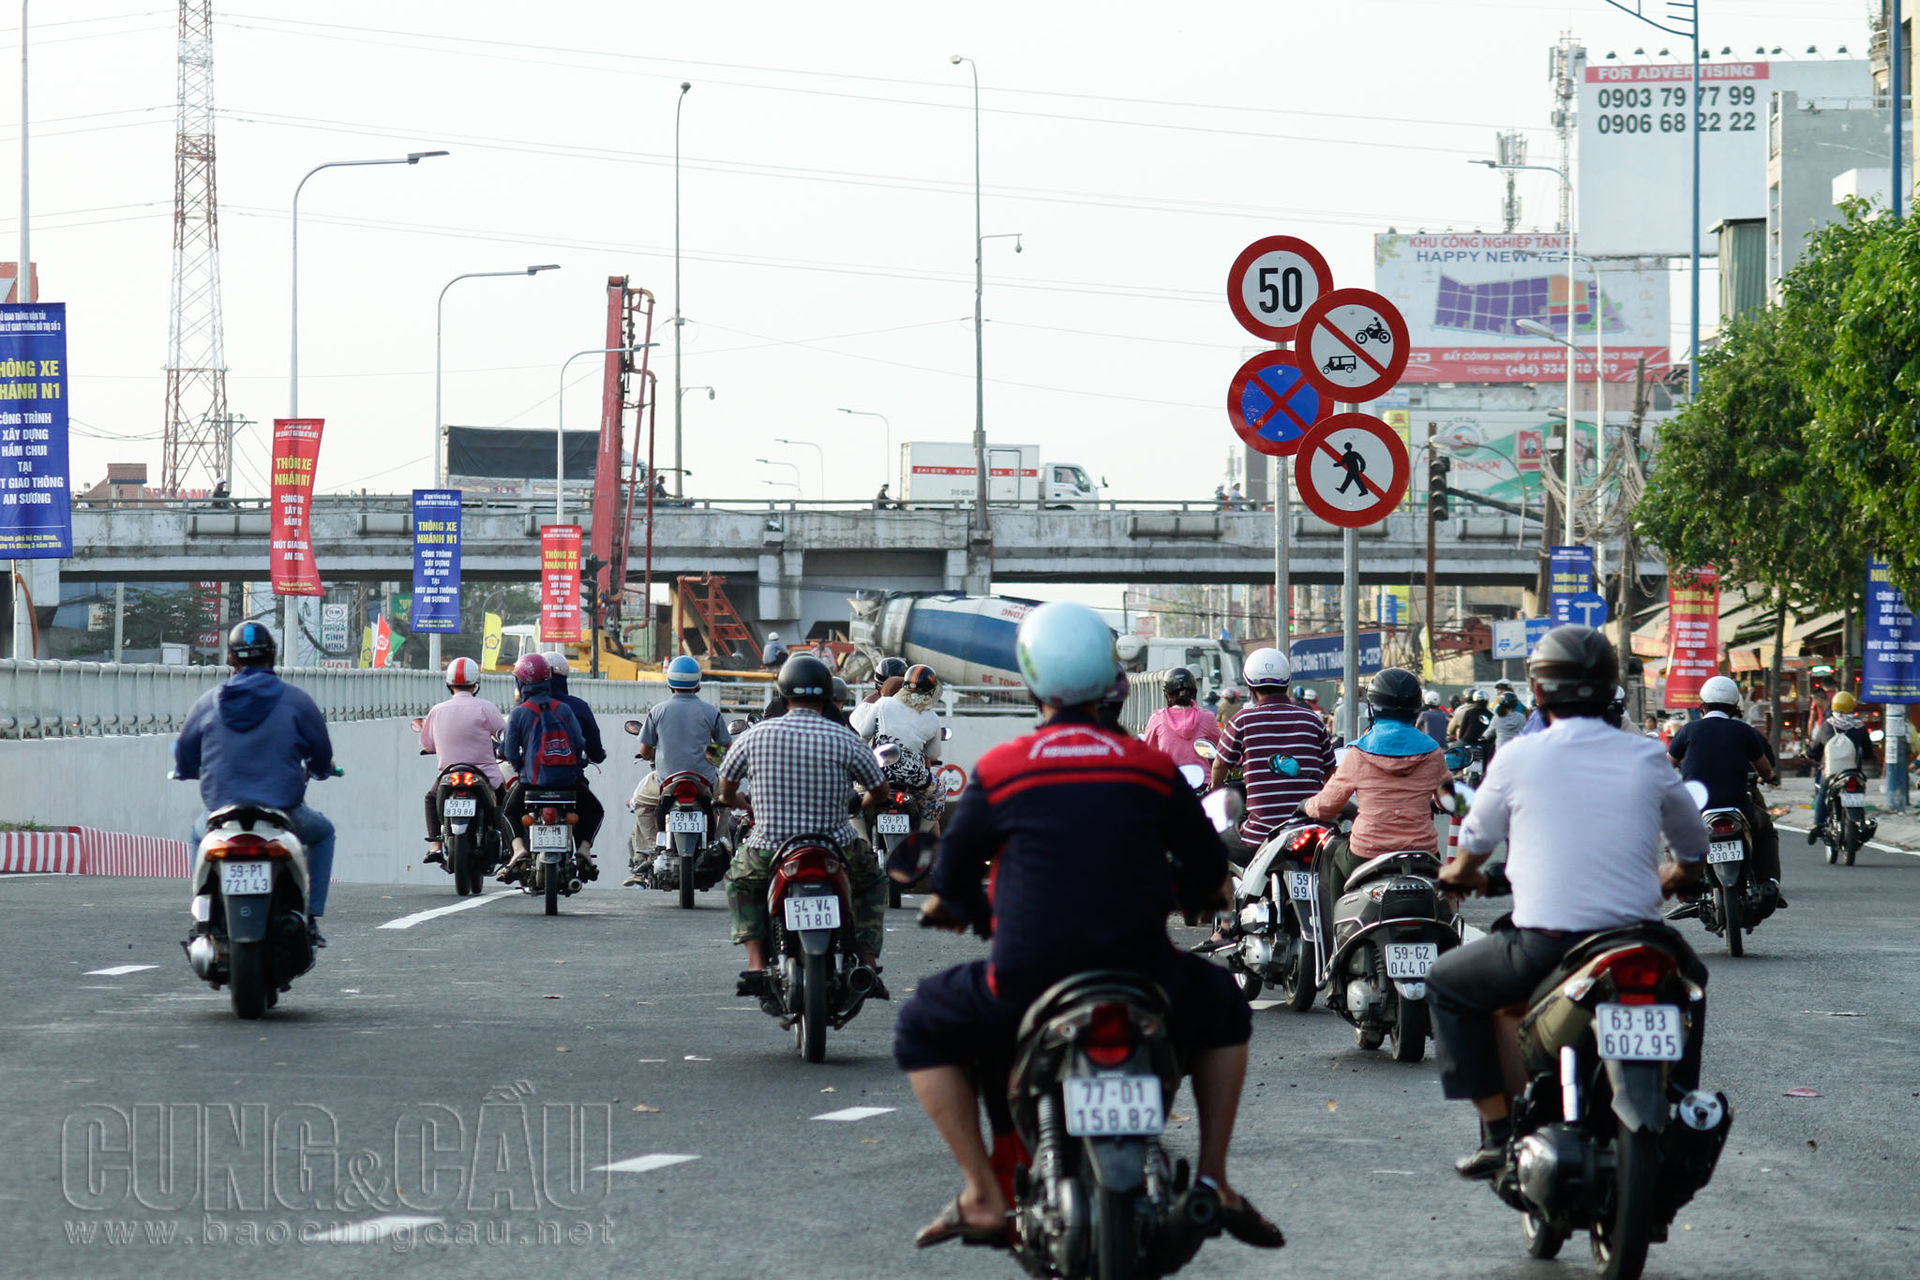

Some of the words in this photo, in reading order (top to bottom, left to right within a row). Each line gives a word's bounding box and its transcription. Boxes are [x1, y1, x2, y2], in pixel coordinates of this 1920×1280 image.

[1598, 67, 1632, 80] FOR
[1637, 64, 1756, 79] ADVERTISING
[1598, 88, 1652, 108] 0903
[1660, 87, 1687, 107] 79
[1698, 86, 1721, 106] 77
[1728, 86, 1755, 106] 99
[1598, 113, 1652, 134] 0906
[1660, 112, 1687, 132] 68
[1698, 112, 1721, 132] 22
[1729, 111, 1756, 131] 22
[1410, 237, 1438, 248] KHU
[1441, 234, 1480, 248] CÔNG
[1483, 236, 1532, 250] NGHIỆP
[1536, 235, 1564, 248] TÂN
[1417, 251, 1480, 262] HAPPY
[1487, 251, 1528, 262] NEW
[1259, 267, 1302, 313] 50
[40, 360, 61, 378] XE
[41, 382, 60, 399] N1
[24, 410, 52, 424] TRÌNH
[2, 428, 21, 441] XÂY
[22, 428, 49, 443] DỰNG
[25, 445, 48, 456] CHUI
[18, 461, 32, 475] TẠI
[8, 477, 30, 489] GIAO
[31, 474, 64, 489] THÔNG
[3, 493, 17, 505] AN
[418, 519, 444, 531] THÔNG
[446, 522, 457, 531] XE
[417, 532, 444, 544] NHÁNH
[446, 534, 457, 544] N1
[230, 864, 263, 878] 59-P1
[793, 899, 832, 913] 54-V4
[795, 913, 832, 928] 1180
[1391, 961, 1433, 975] 044.0
[1611, 1010, 1667, 1031] 63-B3
[1605, 1034, 1676, 1056] 602.95
